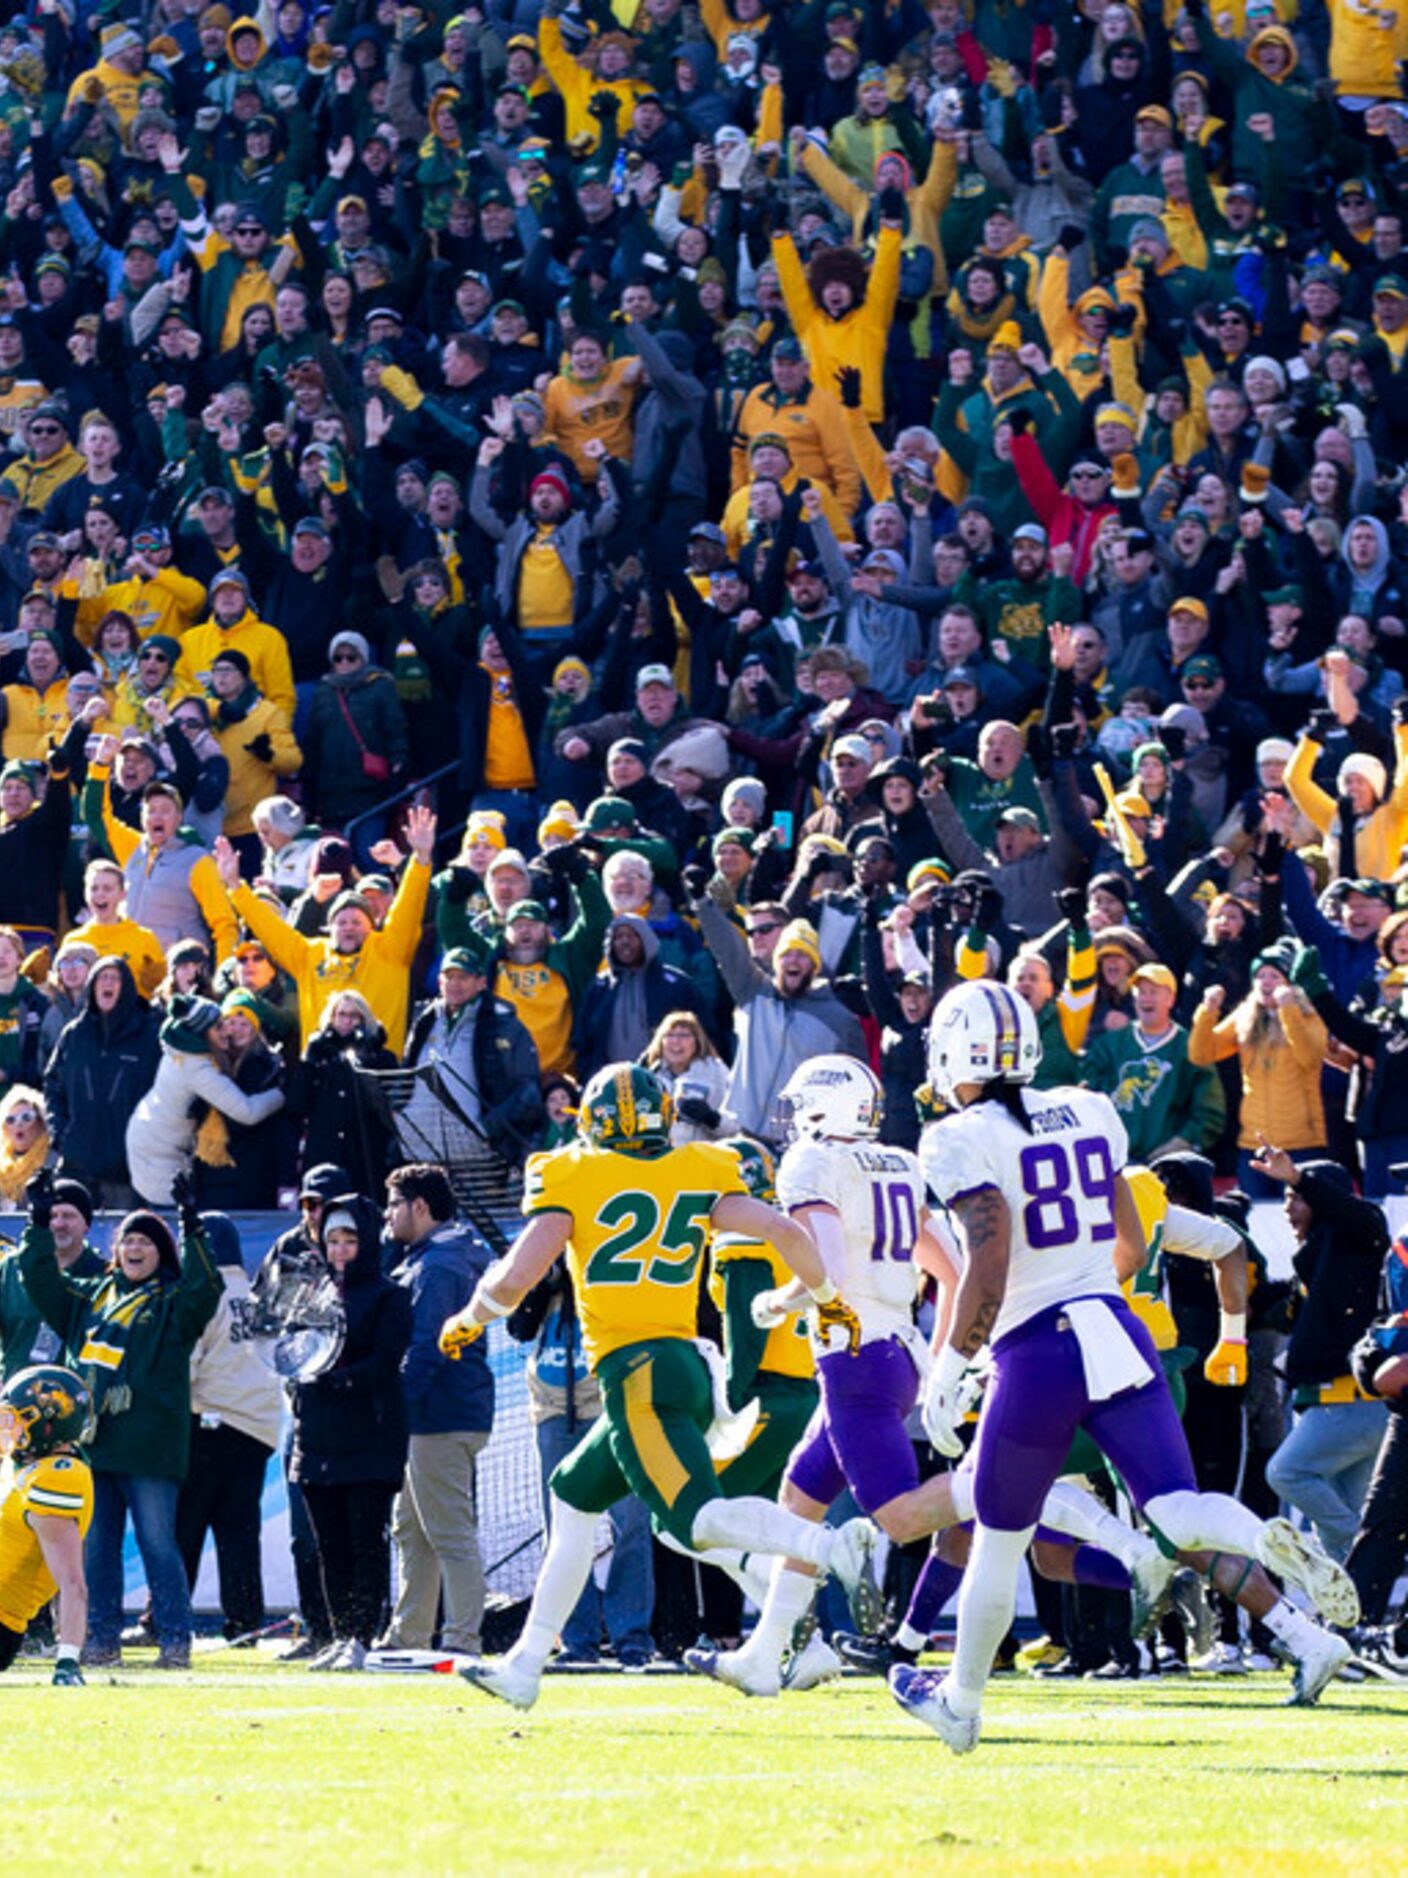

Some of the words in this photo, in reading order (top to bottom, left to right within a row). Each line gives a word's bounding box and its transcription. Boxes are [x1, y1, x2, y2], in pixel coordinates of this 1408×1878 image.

[585, 1190, 721, 1286] 25
[870, 1181, 919, 1262] 10
[1019, 1136, 1116, 1250] 89
